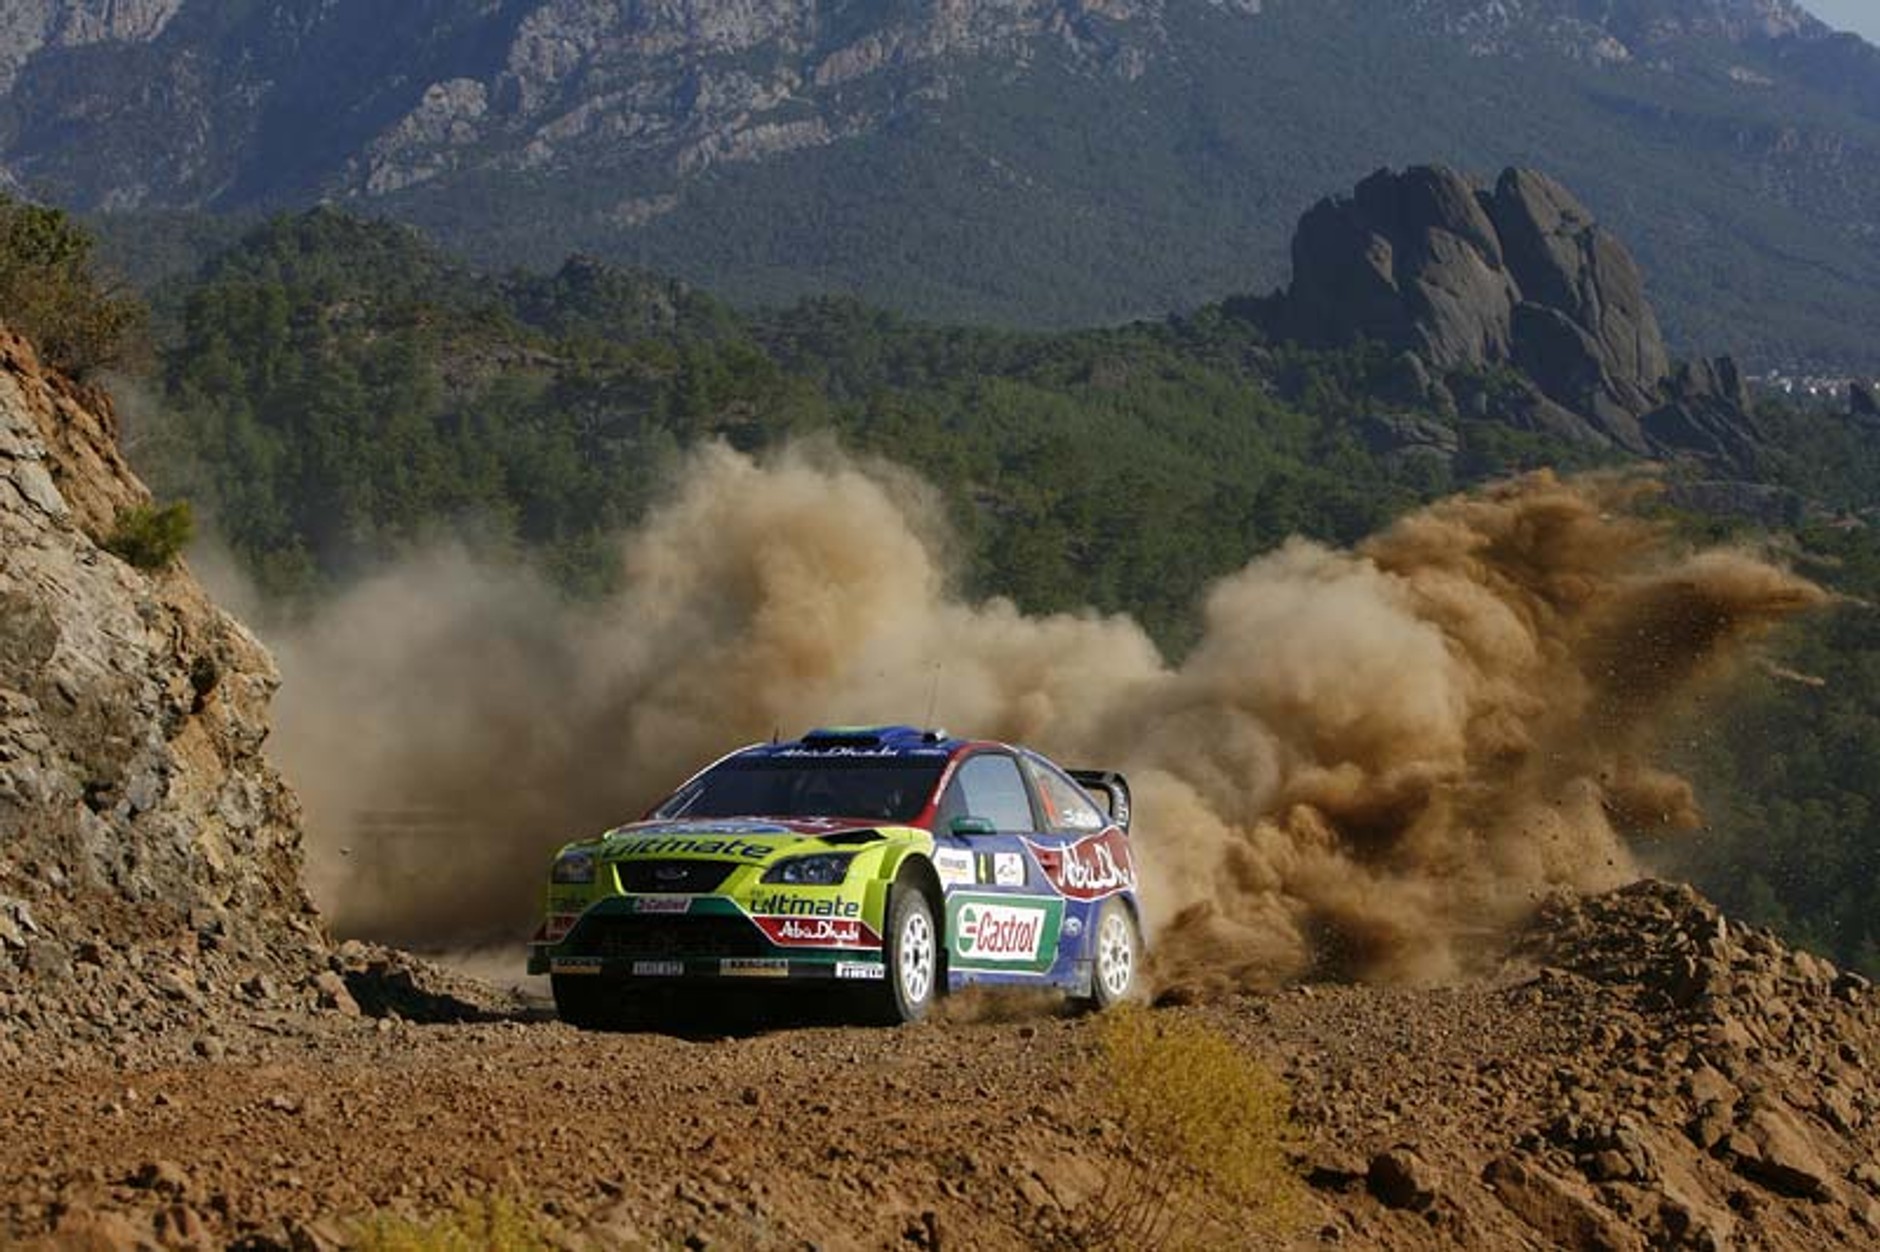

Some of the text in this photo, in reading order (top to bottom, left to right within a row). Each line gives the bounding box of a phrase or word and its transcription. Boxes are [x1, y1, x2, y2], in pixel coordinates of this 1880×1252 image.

[602, 838, 774, 860] ultimate
[750, 893, 860, 918] ultimate
[777, 920, 859, 940] Abu Dhabi
[977, 911, 1038, 953] Castrol
